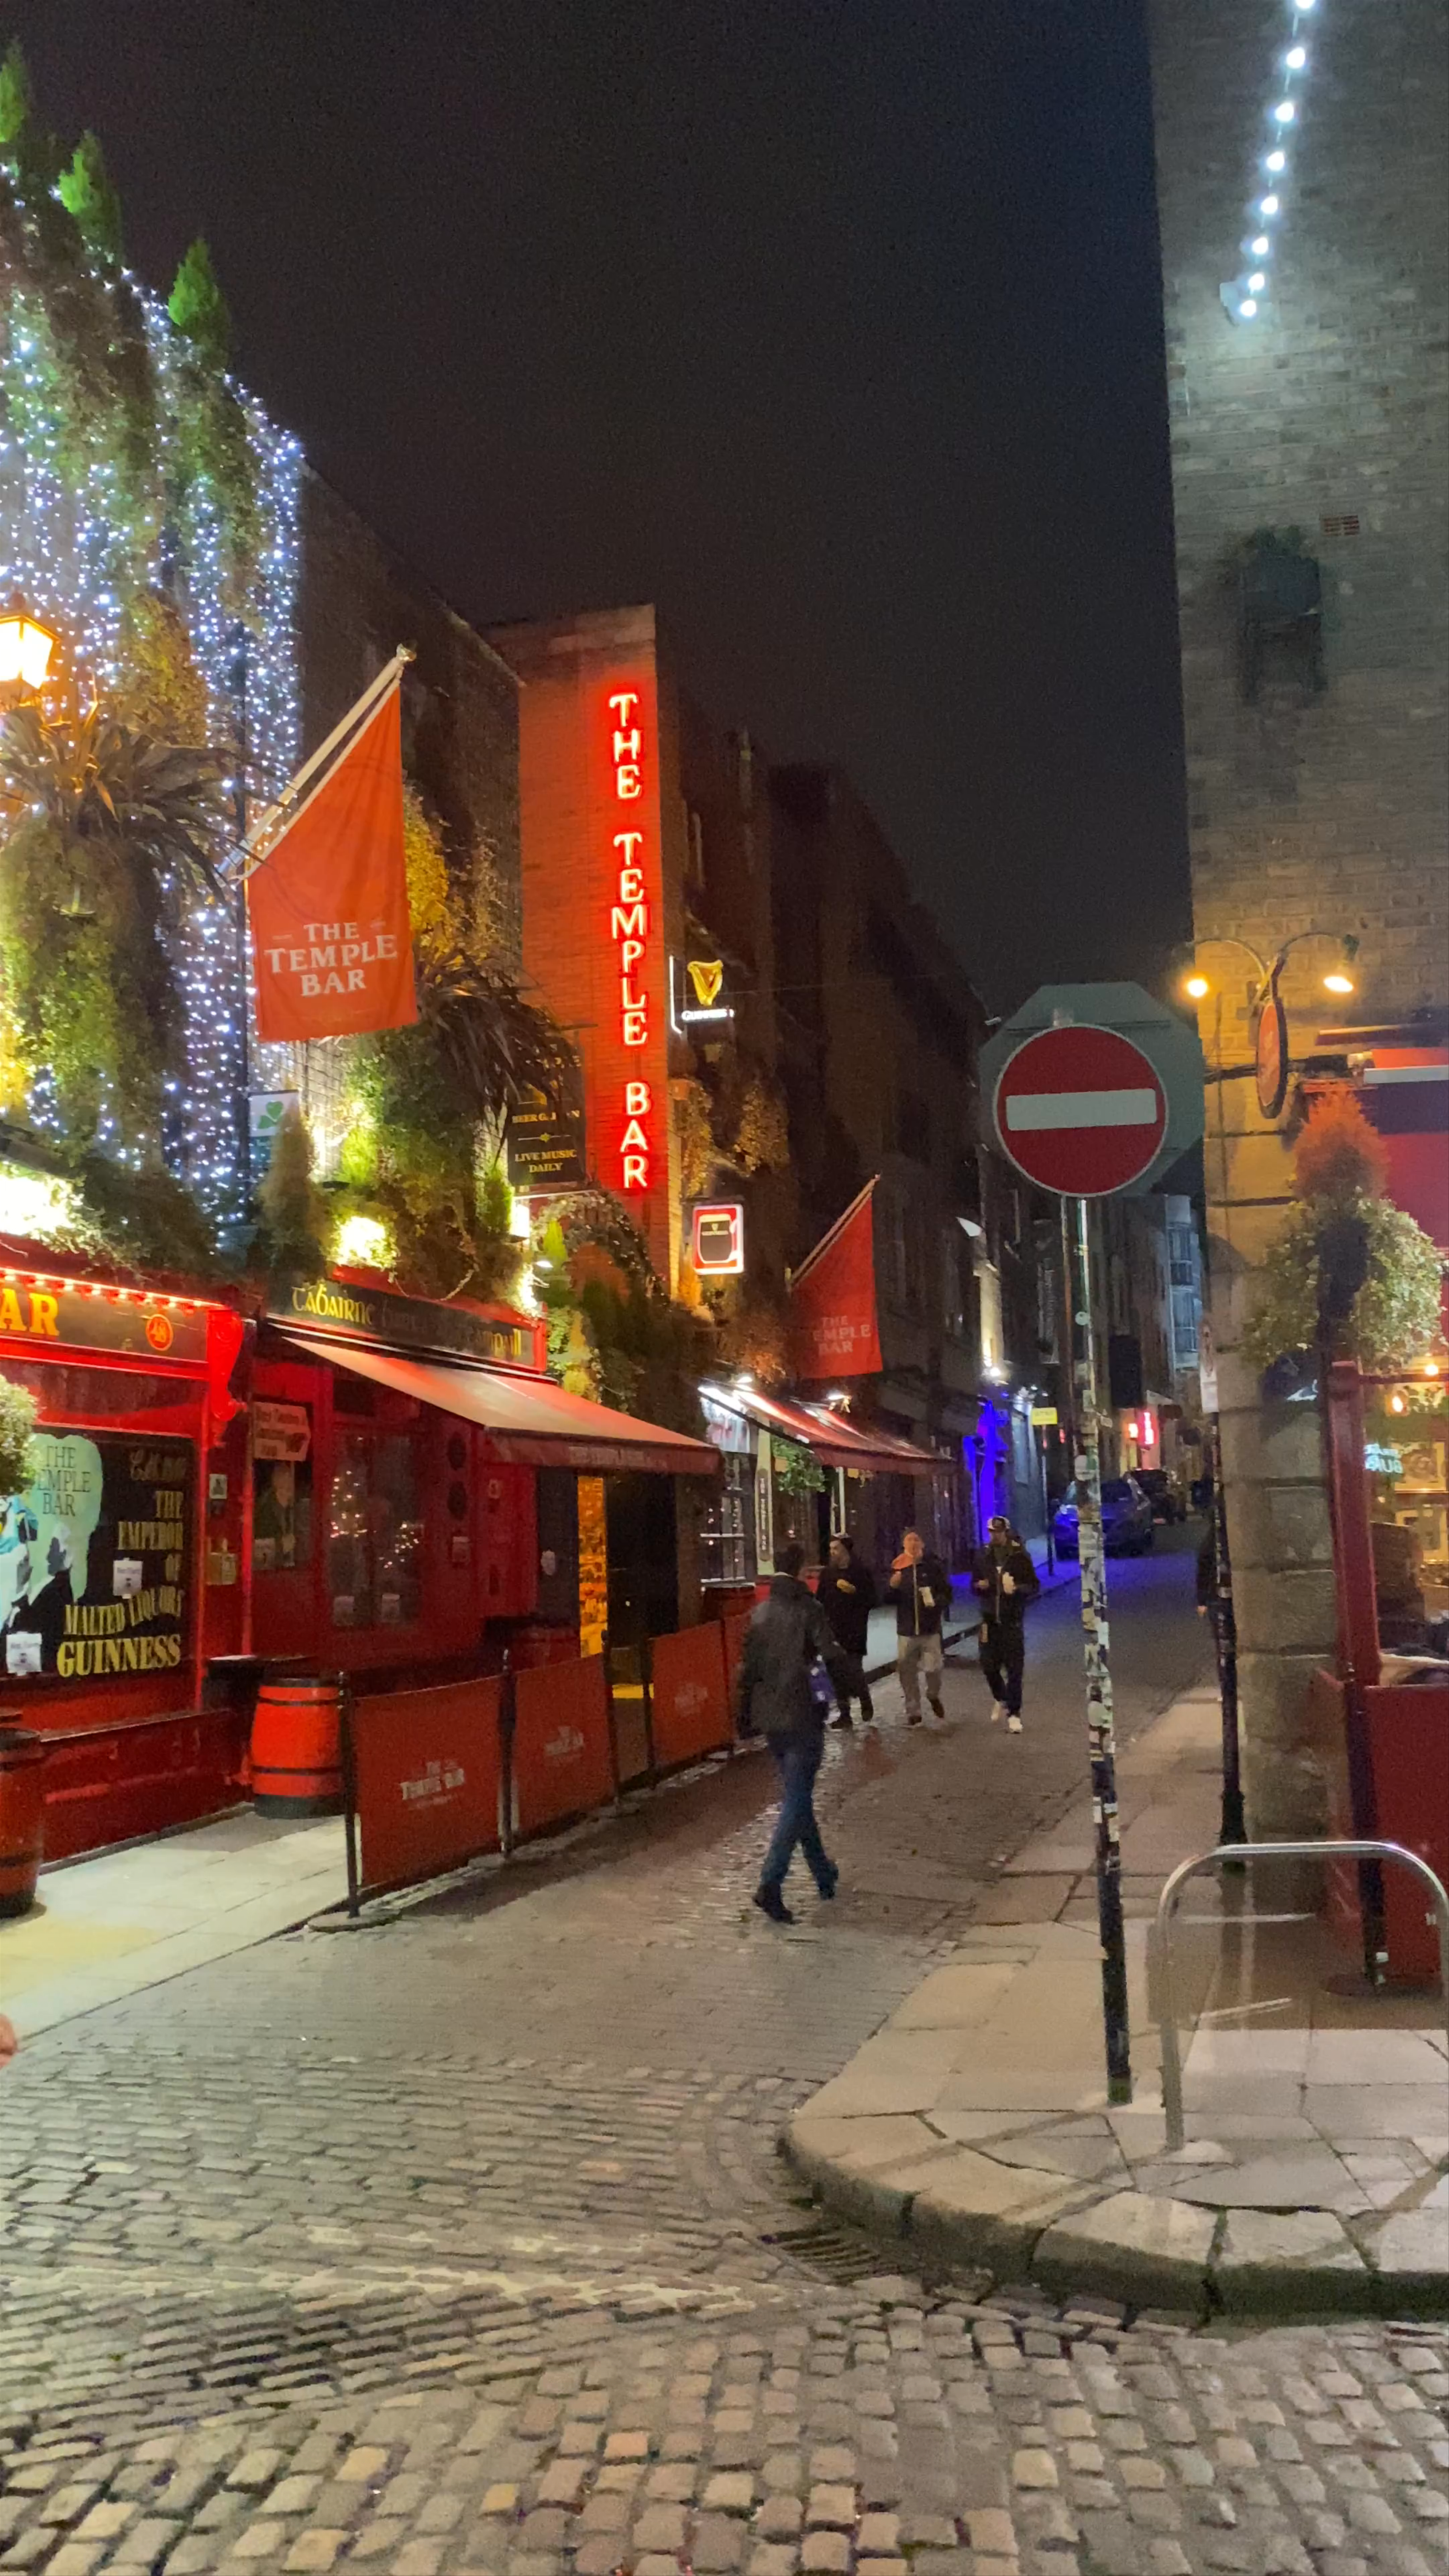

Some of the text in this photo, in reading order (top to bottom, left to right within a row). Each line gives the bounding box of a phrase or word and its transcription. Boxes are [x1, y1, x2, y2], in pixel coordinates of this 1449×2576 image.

[303, 921, 360, 943] THE
[609, 692, 651, 1189] THE TEMPLE BAR
[264, 934, 398, 974] TEMPLE
[300, 969, 367, 998] BAR
[515, 1149, 577, 1162] LIVE MUSIC
[529, 1162, 564, 1173] DAILY
[46, 1446, 76, 1469] THE
[42, 1493, 76, 1517] BAR
[56, 1634, 182, 1678] GUINNESS
